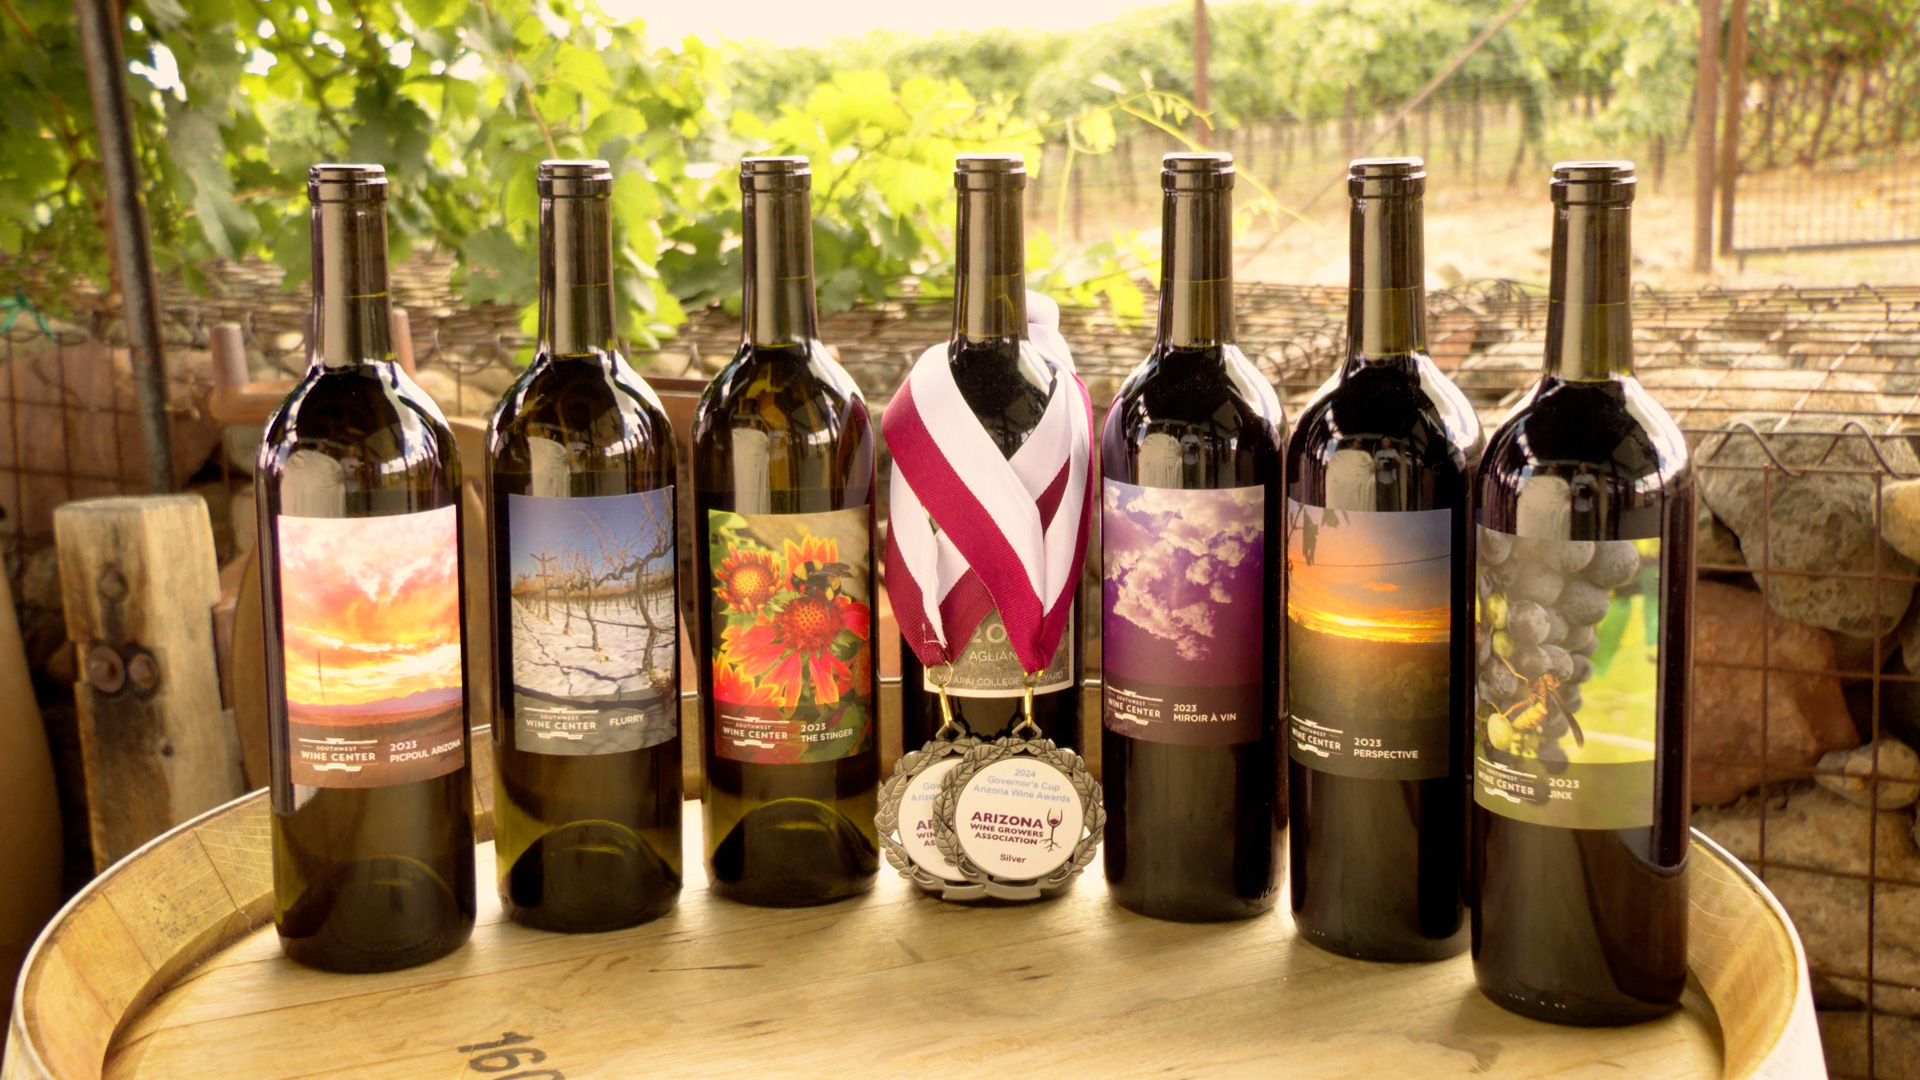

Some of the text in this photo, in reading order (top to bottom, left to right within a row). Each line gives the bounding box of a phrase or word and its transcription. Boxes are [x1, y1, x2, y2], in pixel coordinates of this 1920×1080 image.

[970, 623, 1007, 643] 20
[969, 651, 1018, 662] AGLIAN
[976, 677, 1021, 687] COLLEGE
[1116, 694, 1146, 706] SOUTHWEST
[1107, 697, 1161, 718] WINE CENTER
[1173, 703, 1197, 712] 2023
[609, 713, 645, 727] FLURRY
[1173, 712, 1237, 722] MIROIR À VIN
[525, 719, 597, 730] WINE CENTER
[735, 722, 771, 730] SOUTHWEST
[801, 722, 826, 733] 2023
[1299, 724, 1327, 737] SOUTHWEST
[723, 726, 788, 740] WINE CENTER
[801, 728, 853, 743] THE STINGER
[1291, 727, 1341, 750] WINE CENTER
[390, 740, 418, 752] 2023
[1354, 737, 1382, 747] 2023
[301, 750, 376, 762] WINE CENTER
[389, 739, 461, 763] PICPOUL ARIZONA
[1353, 748, 1419, 759] PERSPECTIVE
[1014, 768, 1036, 778] 2024
[987, 775, 1060, 792] Governor's Cup
[1477, 769, 1535, 796] WINE CENTER
[1548, 777, 1580, 789] 2023
[911, 794, 936, 802] Arizo
[973, 784, 1071, 804] Arizona Wine Awards
[1547, 789, 1573, 800] JINX
[971, 811, 1044, 829] ARIZONA
[970, 822, 1044, 838] WINE GROWERS
[975, 832, 1038, 845] ASSOCIATION
[999, 854, 1026, 864] Silver
[457, 1031, 565, 1080] 16
